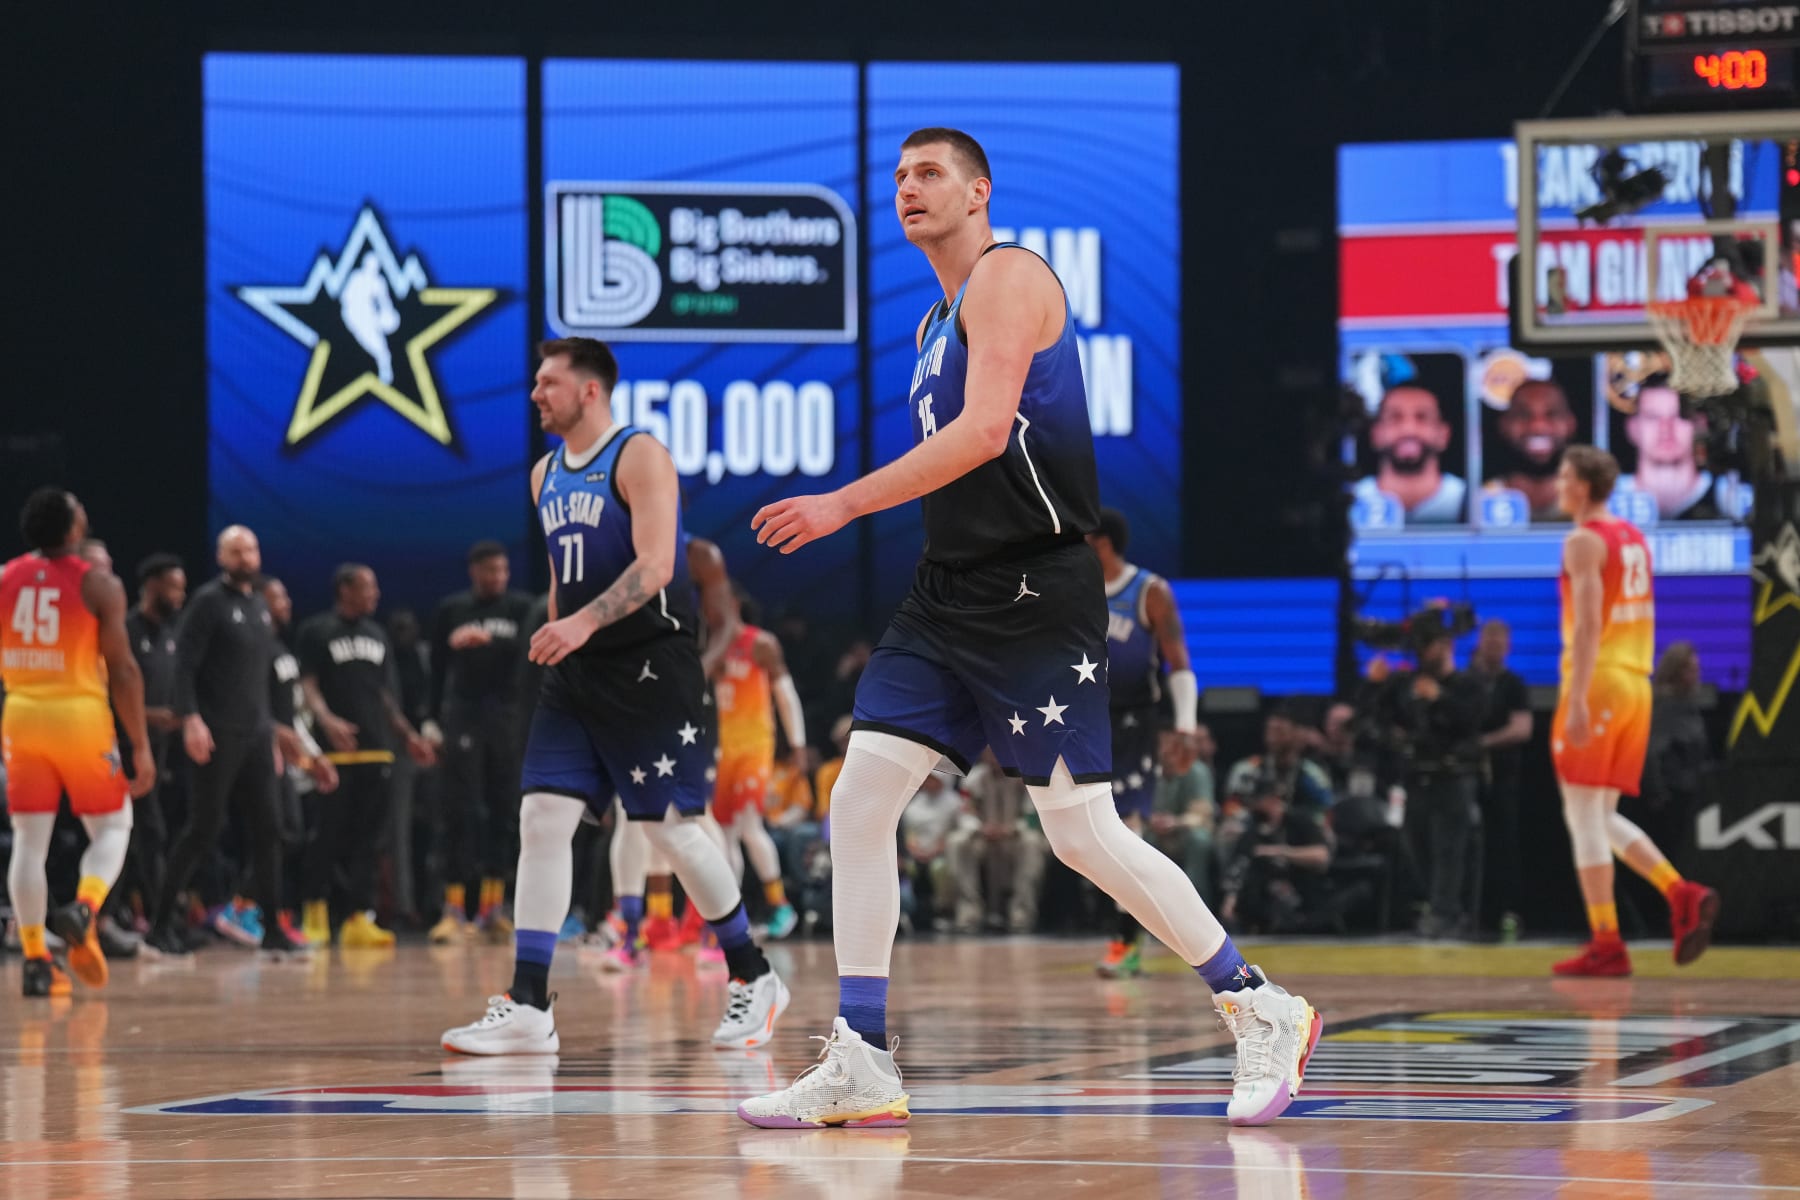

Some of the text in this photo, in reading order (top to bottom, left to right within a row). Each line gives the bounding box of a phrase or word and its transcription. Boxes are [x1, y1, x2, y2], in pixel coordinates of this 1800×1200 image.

[1687, 7, 1799, 35] TISSOT
[670, 207, 840, 252] Big Brothers
[670, 246, 719, 292] Big
[558, 532, 584, 585] 77
[12, 586, 61, 645] 45
